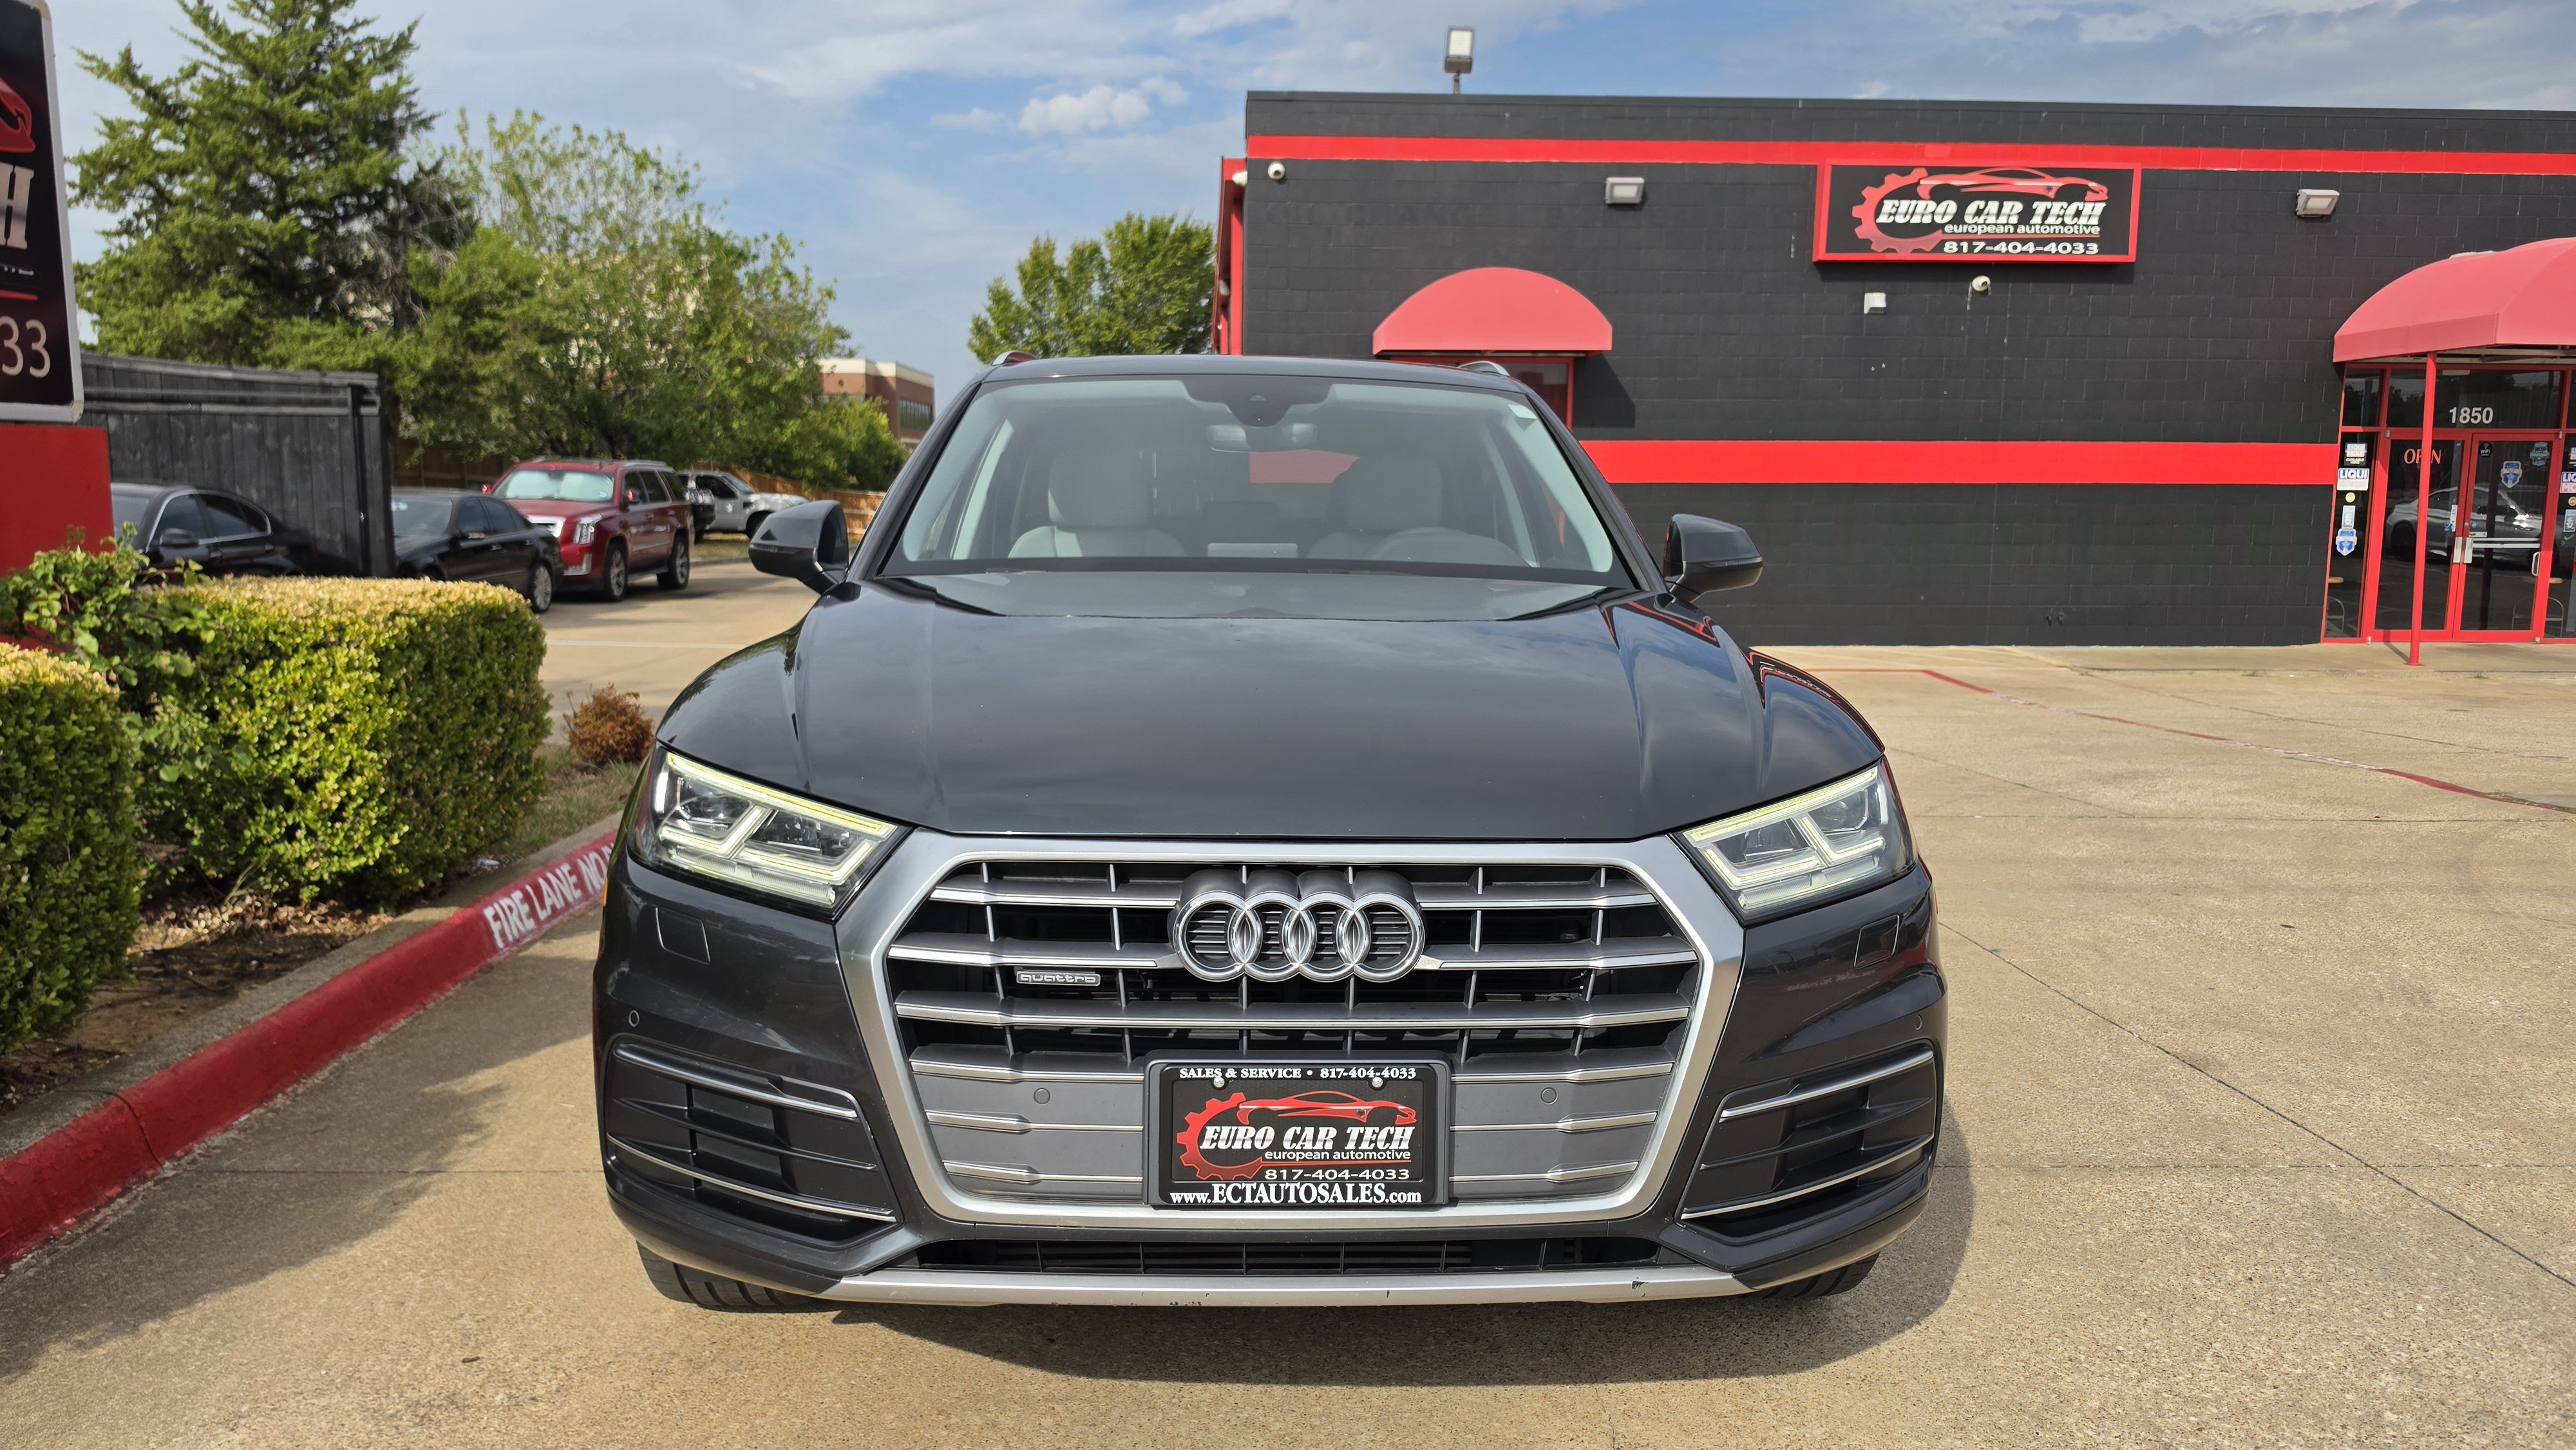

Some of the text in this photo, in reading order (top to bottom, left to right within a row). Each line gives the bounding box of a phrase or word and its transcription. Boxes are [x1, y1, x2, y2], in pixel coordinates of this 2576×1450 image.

[1876, 200, 2107, 225] EURO CAR TECH
[1944, 223, 2100, 235] european automotive
[1944, 241, 2099, 254] 817-404-4033
[2449, 407, 2494, 424] 1850
[2404, 448, 2441, 464] OPN
[2339, 469, 2368, 479] LIQUI
[484, 890, 535, 948] FIRE
[526, 863, 582, 921] LANE
[576, 851, 609, 896] NO
[1020, 974, 1096, 983] quattro
[1179, 1067, 1416, 1078] SALES & SERVICE 817-404-4033
[1200, 1126, 1416, 1150] EURO CAR TECH
[1264, 1150, 1412, 1162] european automotive
[1264, 1169, 1410, 1180] 817-404-4033
[1170, 1183, 1422, 1205] www.ECTAUTOSALES.com
